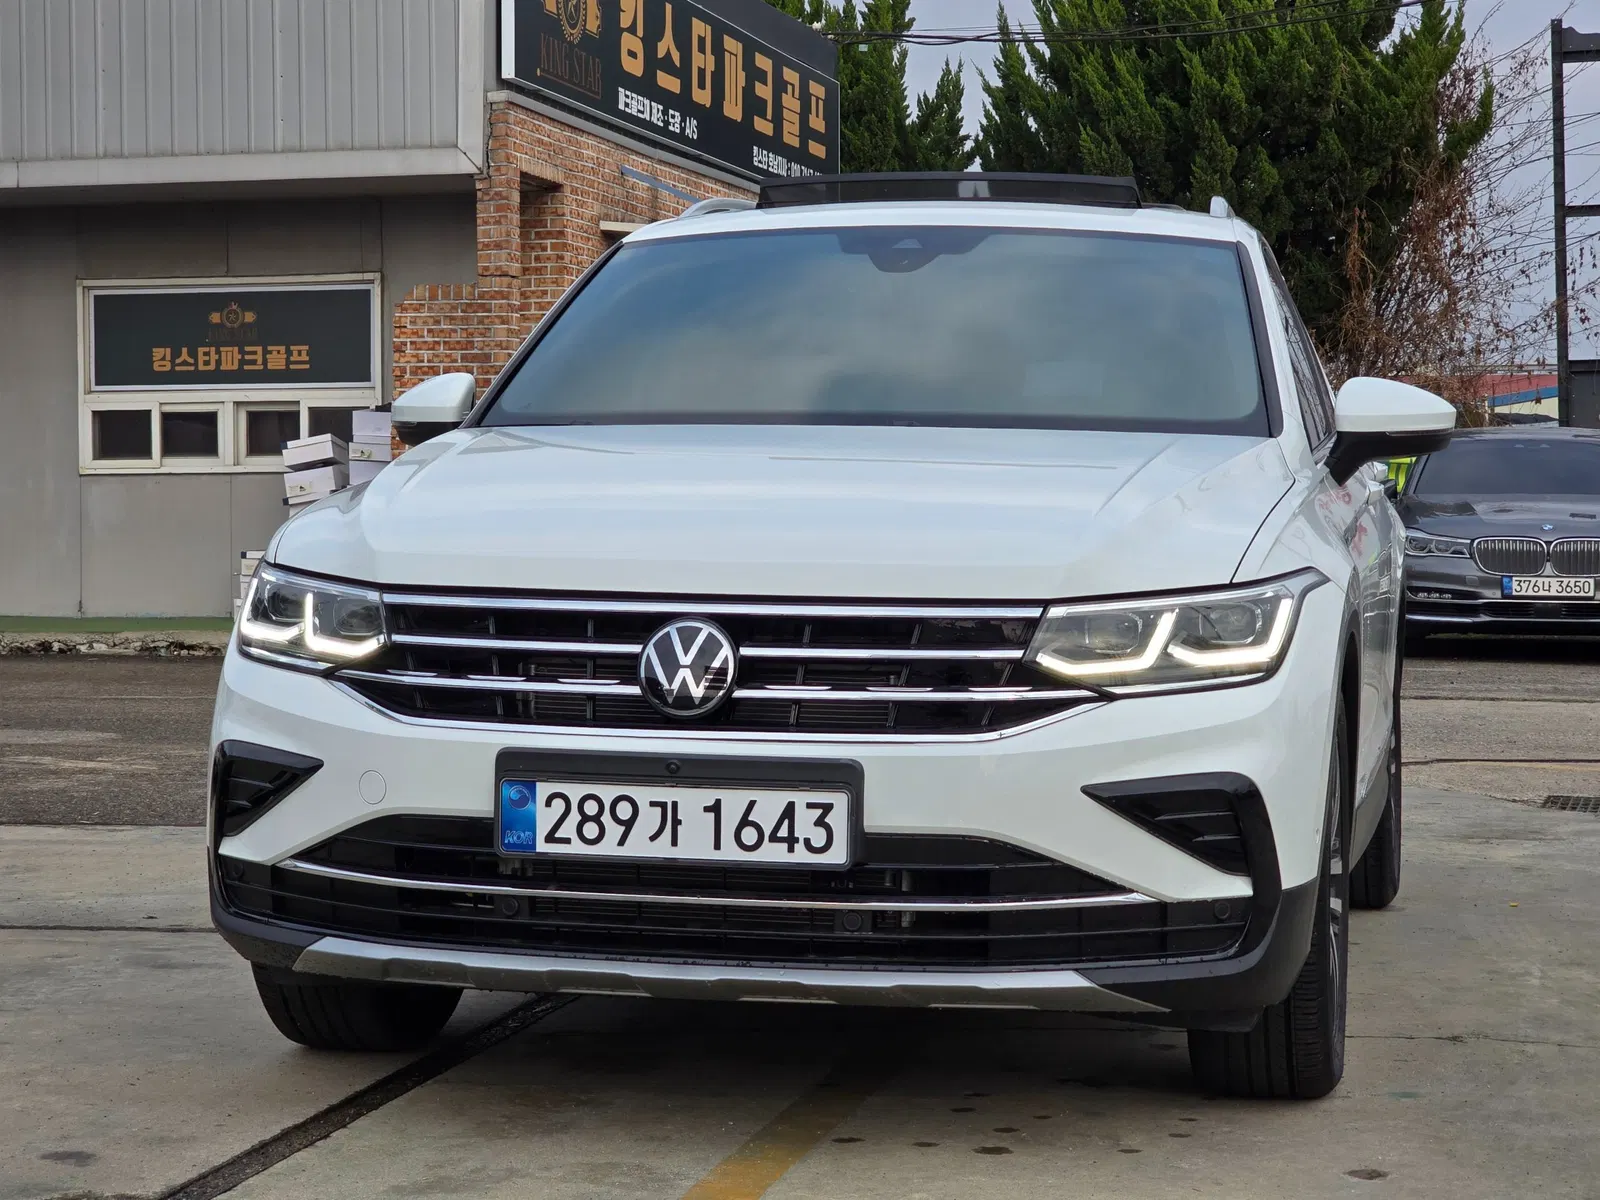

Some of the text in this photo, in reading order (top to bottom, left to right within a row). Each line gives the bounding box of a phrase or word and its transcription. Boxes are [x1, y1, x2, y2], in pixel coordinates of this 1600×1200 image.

[541, 32, 602, 92] KING STAR
[619, 0, 827, 160] 킹스타파크골프
[651, 101, 664, 127] 제조
[668, 108, 681, 134] 도장
[685, 116, 698, 140] A/S
[753, 145, 768, 170] 킹스타
[152, 345, 310, 372] 킹스타파크골프
[1514, 580, 1552, 594] 376나
[1556, 580, 1591, 594] 3650
[504, 830, 534, 845] KOR
[544, 792, 835, 854] 289가 1643
